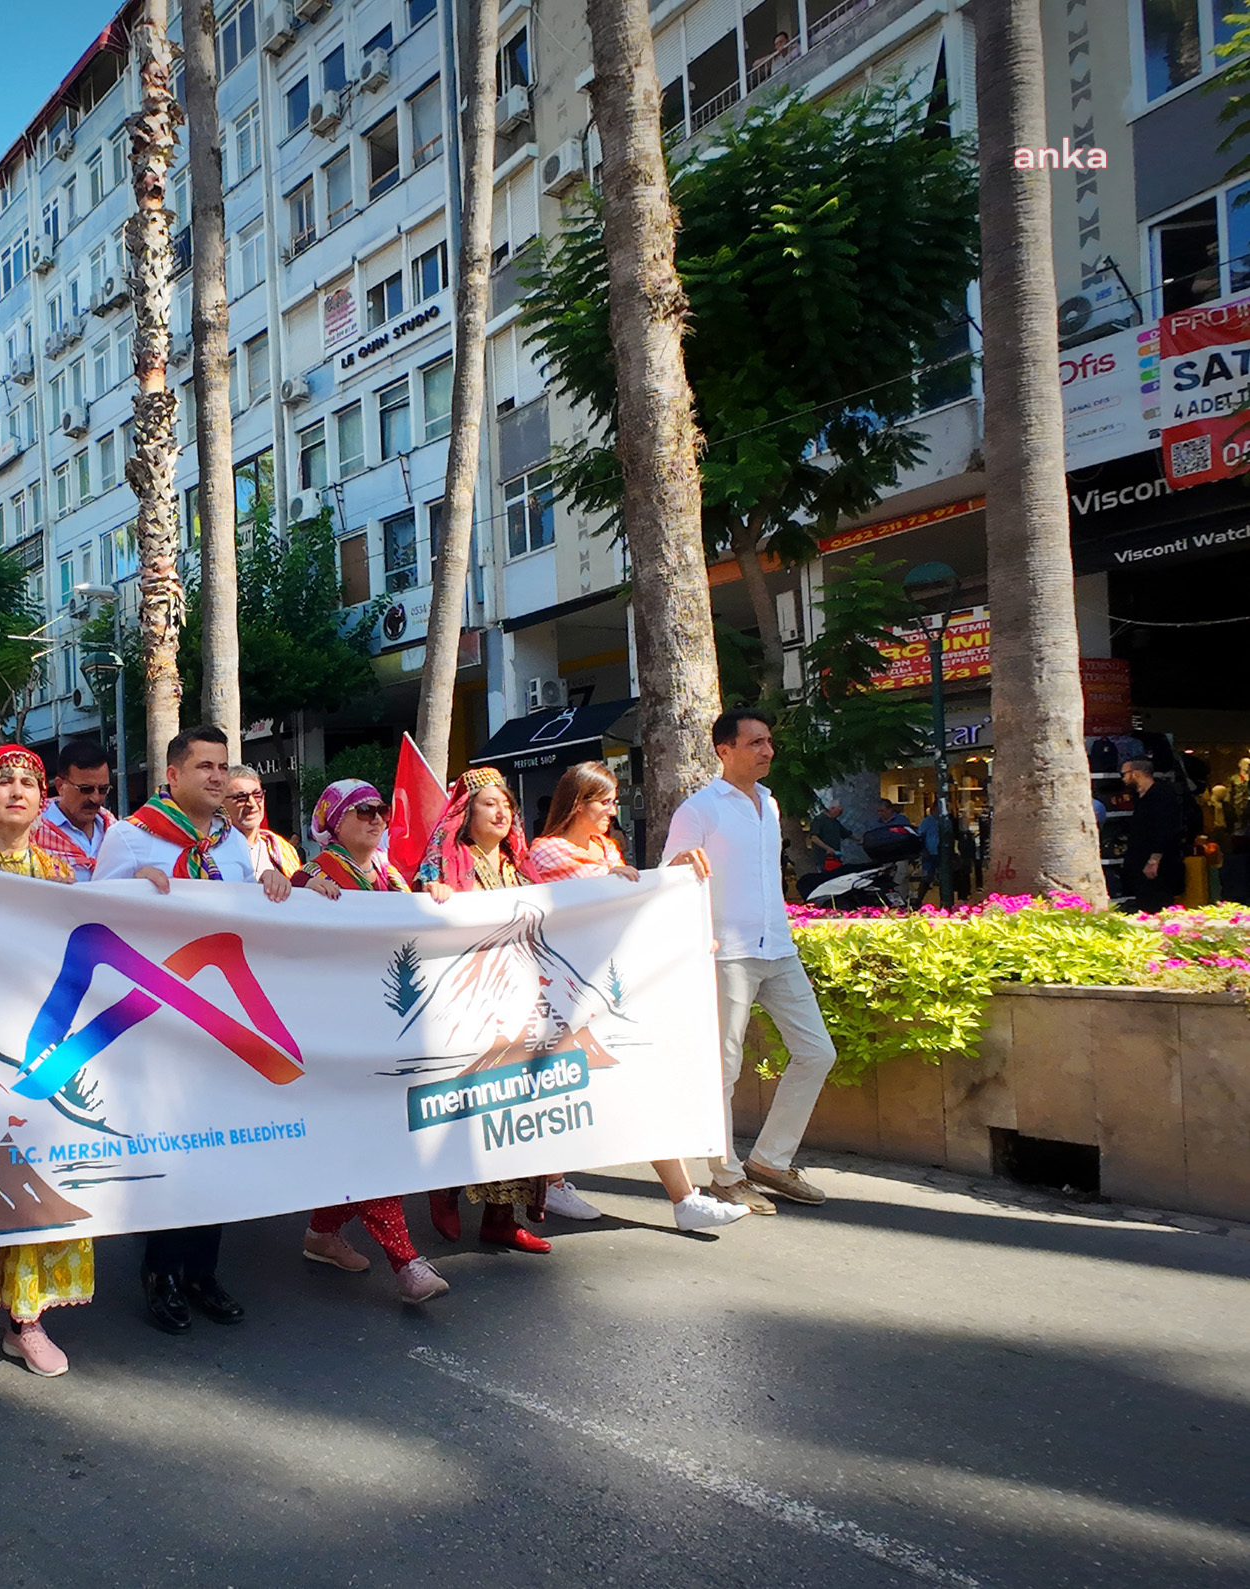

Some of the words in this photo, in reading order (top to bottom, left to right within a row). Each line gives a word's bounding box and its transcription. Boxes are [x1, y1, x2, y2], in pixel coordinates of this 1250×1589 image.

[393, 305, 440, 339] STUDIO
[1114, 538, 1188, 563] Visconti
[420, 1058, 582, 1120] memnuniyetle
[8, 1147, 43, 1165] T.C.
[49, 1136, 123, 1163] MERSİN
[127, 1126, 226, 1155] BÜYÜKŞEHİR
[230, 1117, 307, 1145] BELEDİYESİ
[482, 1095, 594, 1151] Mersin
